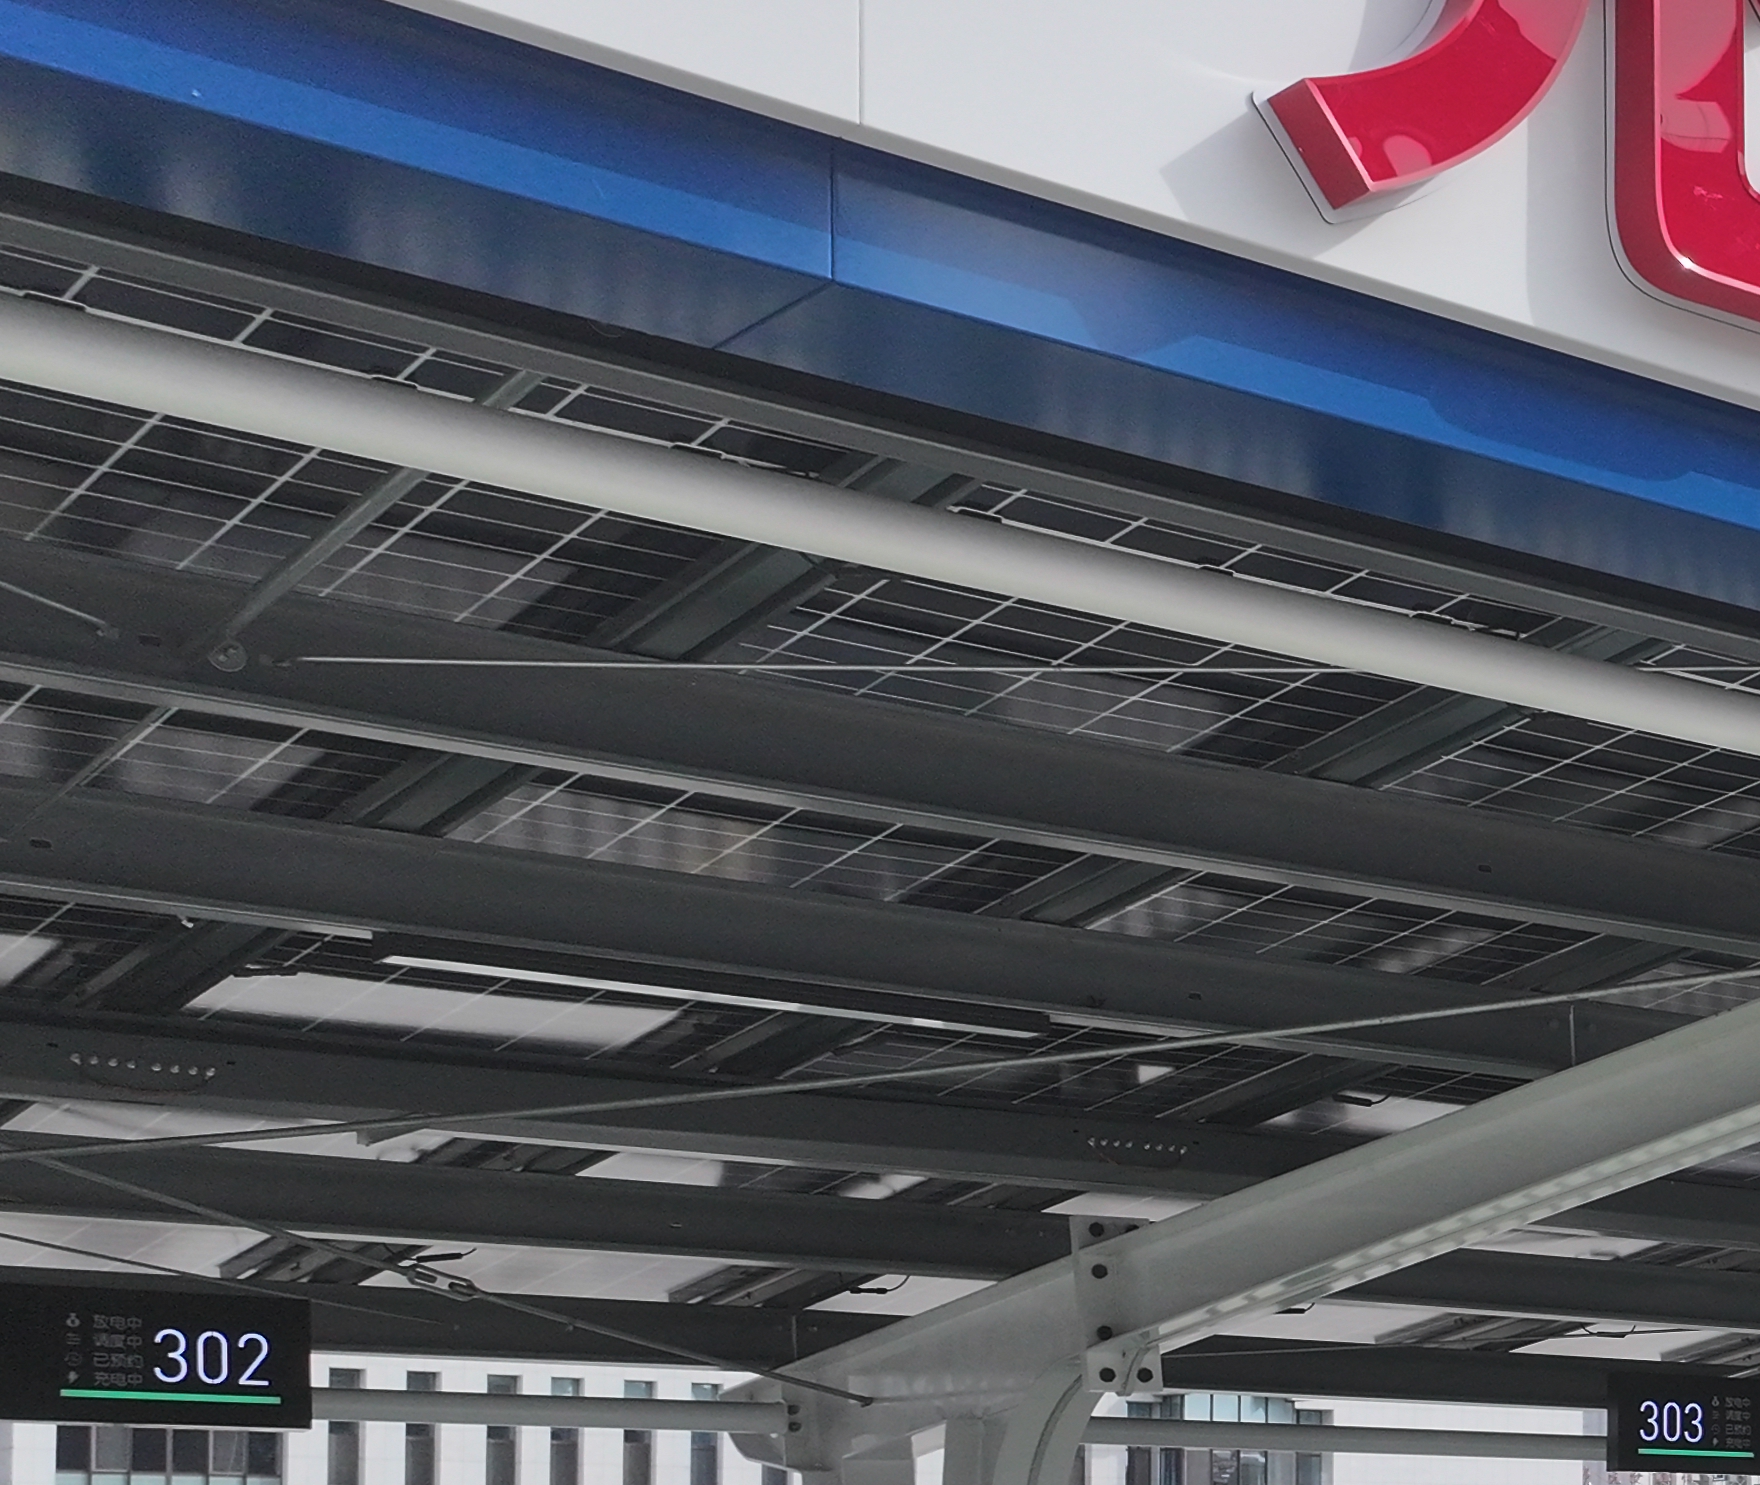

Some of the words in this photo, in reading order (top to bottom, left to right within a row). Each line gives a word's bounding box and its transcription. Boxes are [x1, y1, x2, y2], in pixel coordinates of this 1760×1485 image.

[93, 1371, 144, 1386] 充电中
[152, 1328, 271, 1386] 302
[1638, 1400, 1704, 1443] 303
